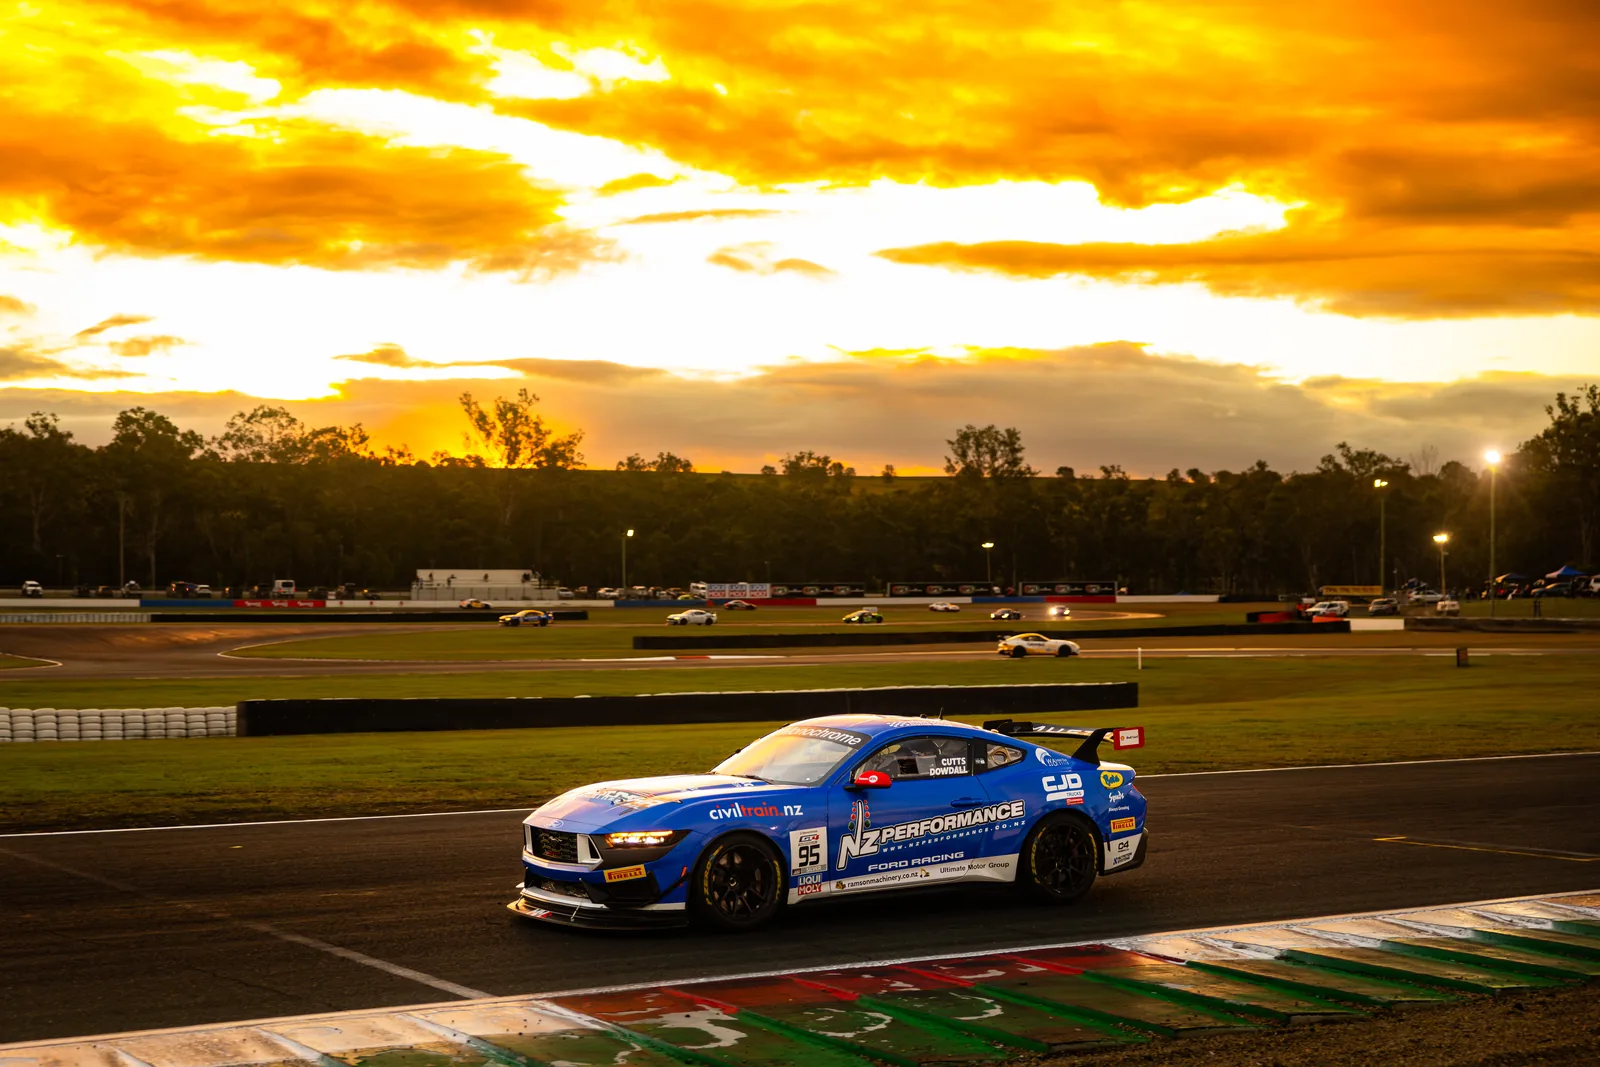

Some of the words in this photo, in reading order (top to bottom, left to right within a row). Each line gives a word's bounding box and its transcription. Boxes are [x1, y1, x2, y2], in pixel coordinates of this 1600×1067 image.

[941, 757, 966, 766] CUTTS
[929, 765, 968, 776] DOWDALL
[1041, 773, 1083, 792] CJD
[709, 802, 804, 820] civiltrain.nz
[880, 800, 1025, 844] PERFORMANCE
[1112, 818, 1134, 831] PIRELLI
[798, 844, 820, 867] 95
[868, 859, 909, 872] FORD
[911, 851, 965, 866] RACING
[607, 867, 643, 881] PIRELLI
[940, 864, 966, 874] Ultimate
[968, 862, 986, 871] Motor
[988, 861, 1010, 870] Group
[799, 874, 821, 885] LIQUI
[847, 871, 919, 887] ramsonmachinery.co.nz
[798, 884, 821, 895] MOLY
